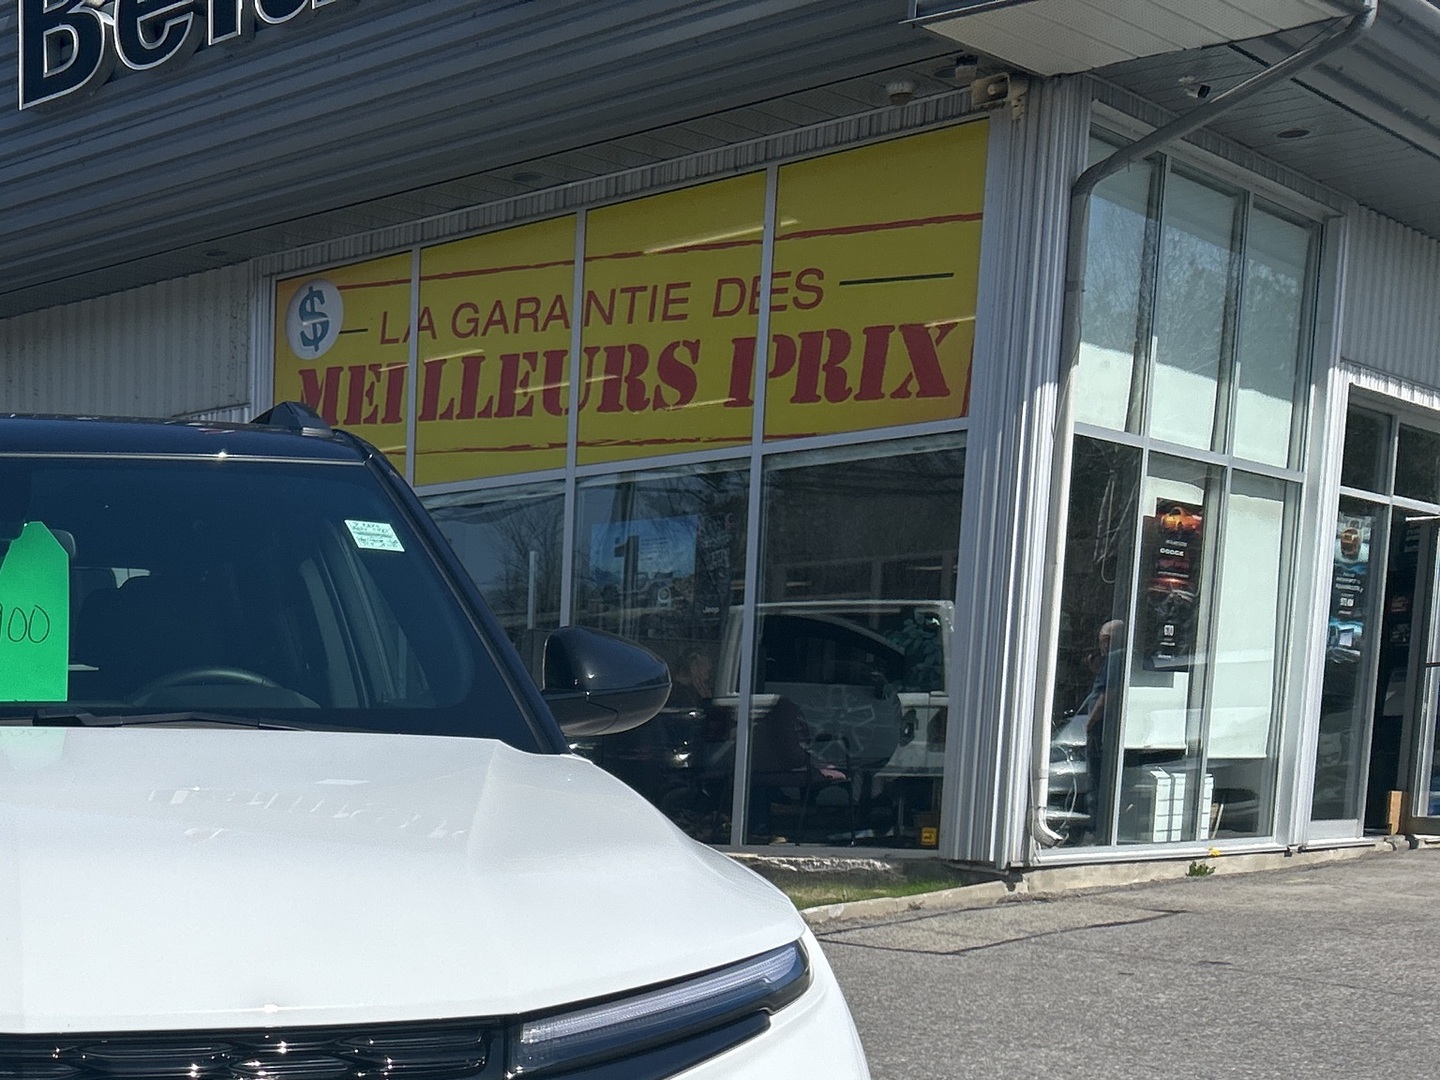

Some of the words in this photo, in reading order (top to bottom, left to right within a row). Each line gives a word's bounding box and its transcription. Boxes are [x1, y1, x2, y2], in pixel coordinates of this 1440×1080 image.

[379, 306, 437, 345] LA
[451, 281, 691, 339] GARANTIE
[712, 268, 825, 318] DES
[298, 338, 701, 427] MEILLEURS
[724, 321, 959, 408] PRIX
